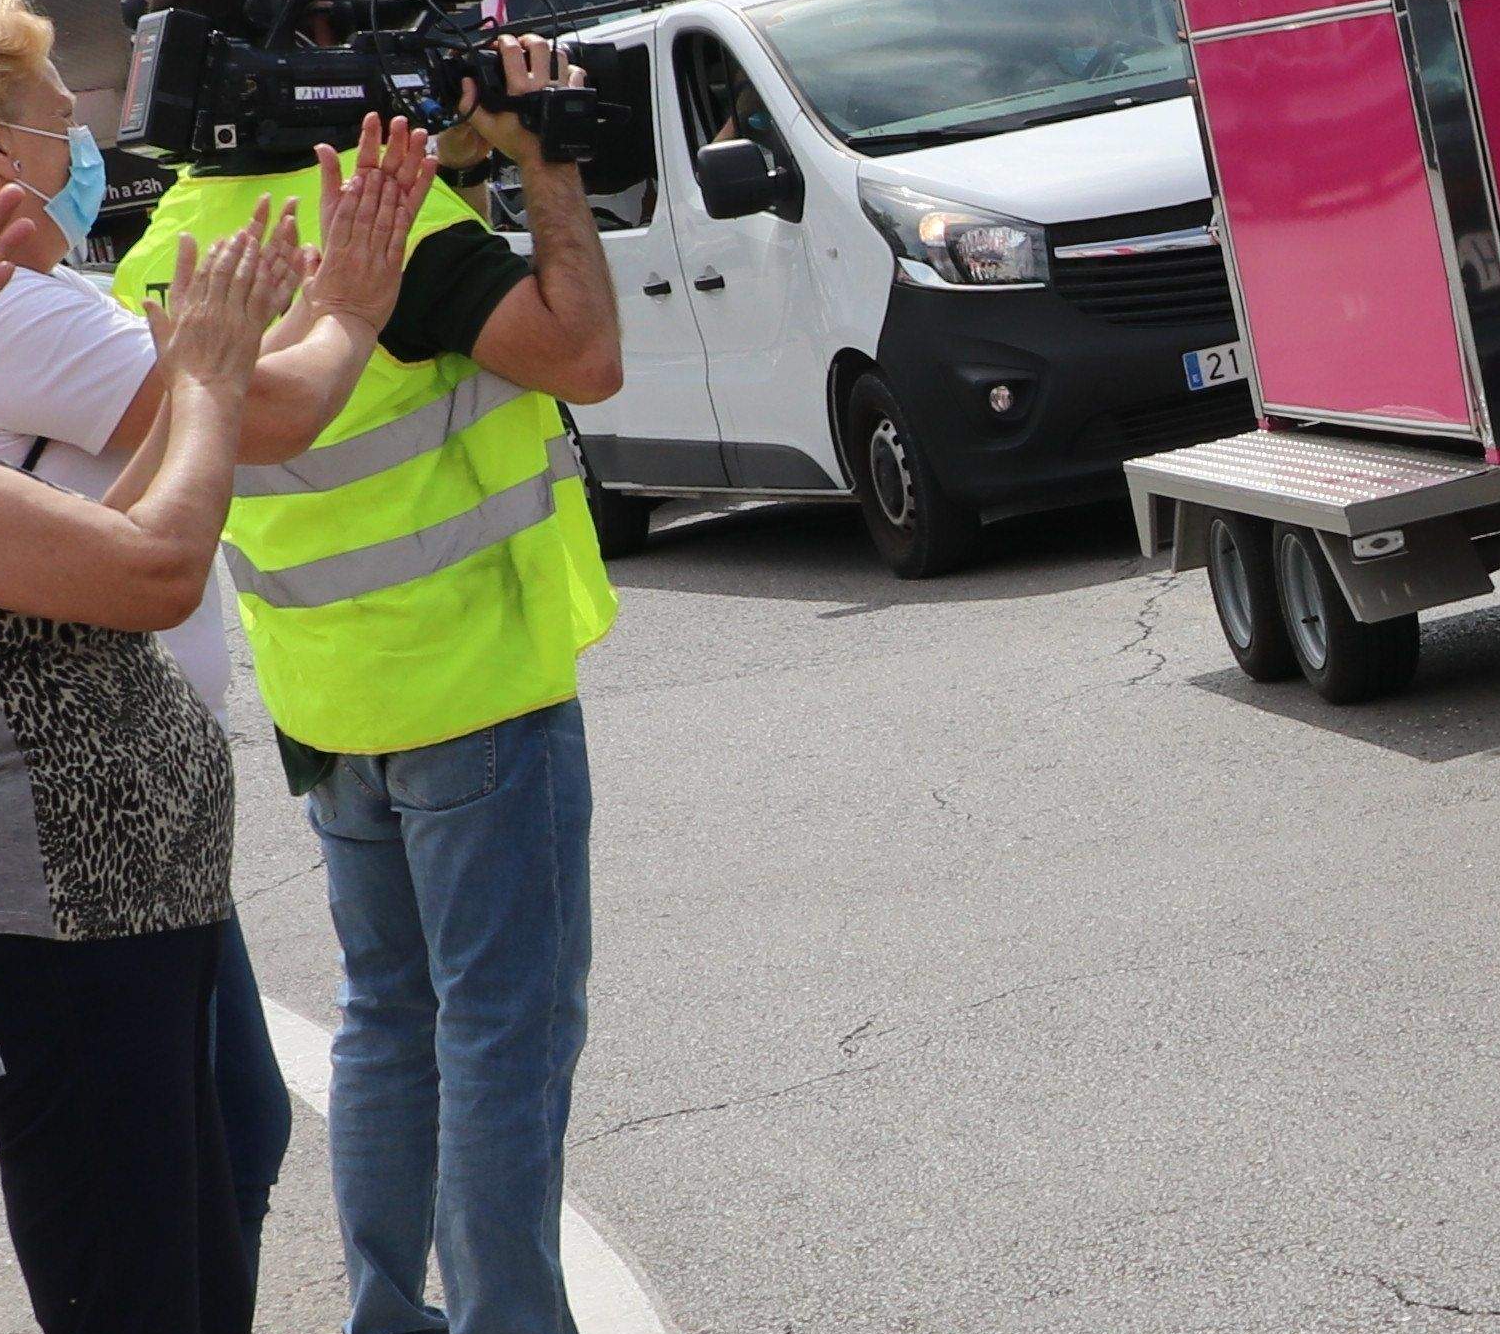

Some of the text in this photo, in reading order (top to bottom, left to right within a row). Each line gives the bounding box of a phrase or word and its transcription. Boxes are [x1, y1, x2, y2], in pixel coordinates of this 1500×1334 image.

[326, 85, 365, 99] LUCENA
[122, 187, 131, 198] a
[132, 177, 164, 197] 23h
